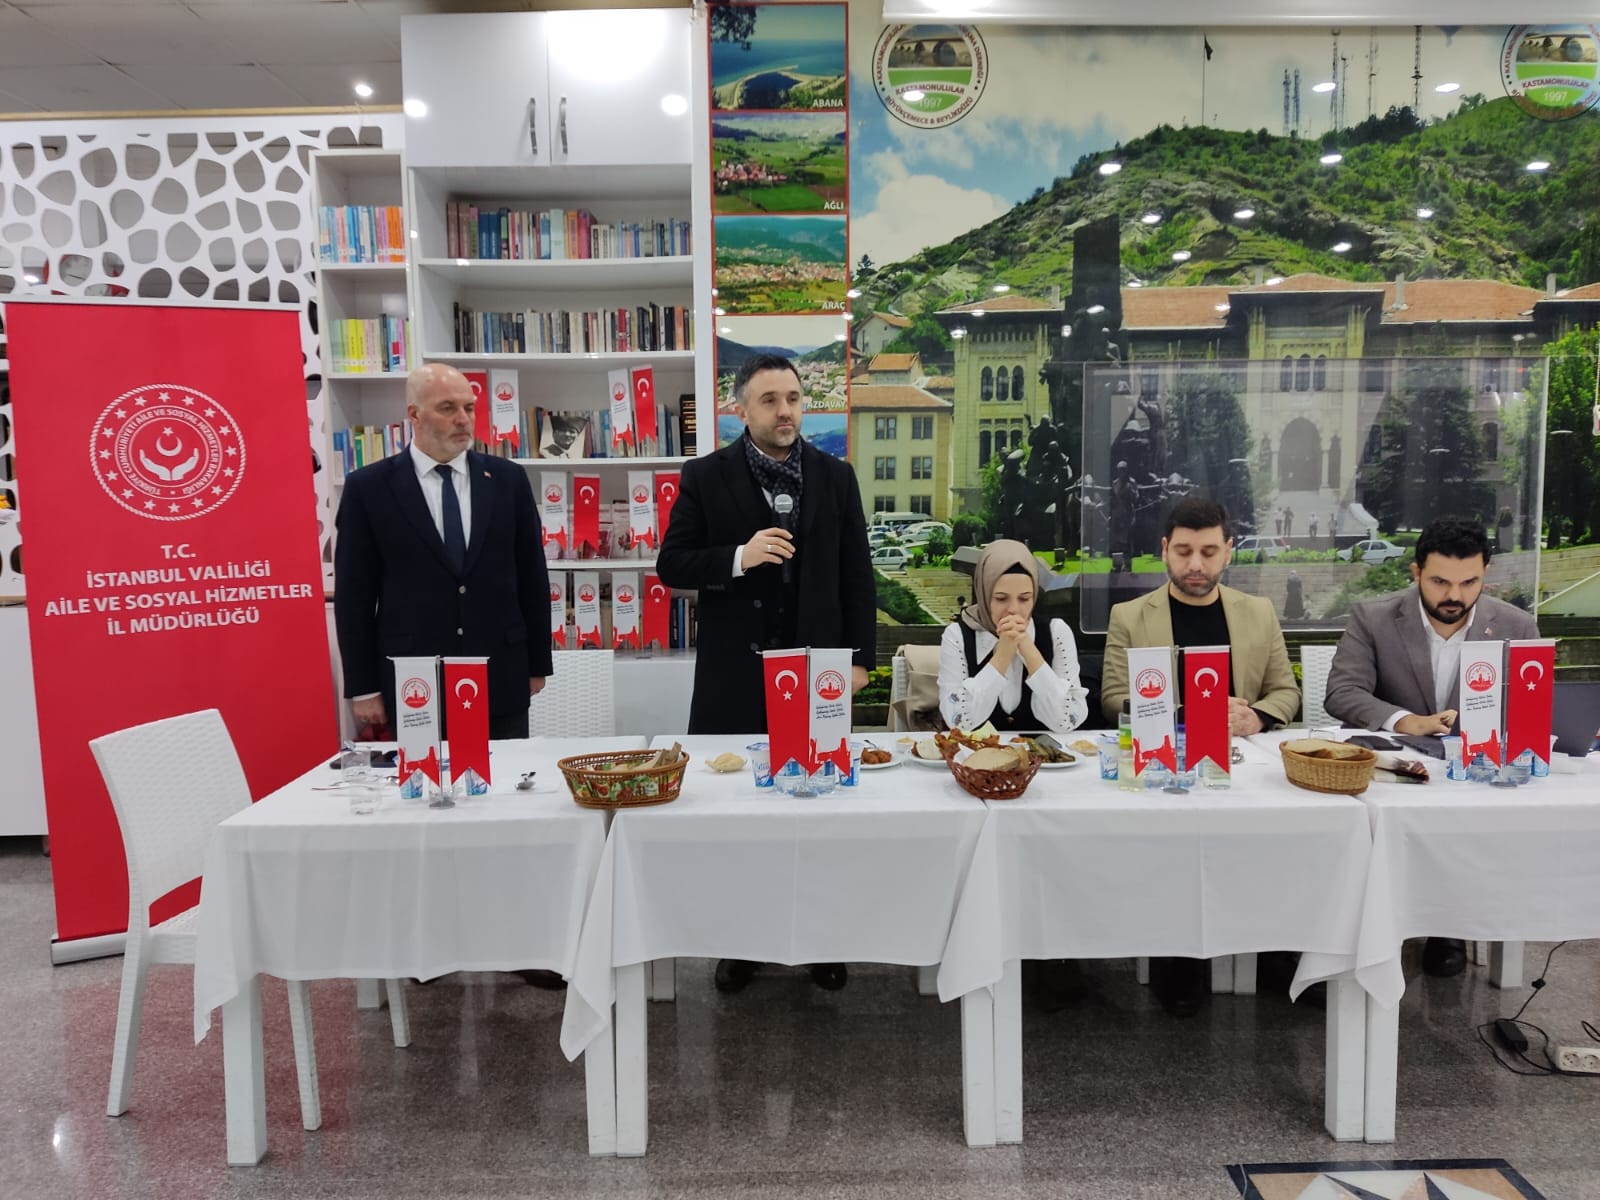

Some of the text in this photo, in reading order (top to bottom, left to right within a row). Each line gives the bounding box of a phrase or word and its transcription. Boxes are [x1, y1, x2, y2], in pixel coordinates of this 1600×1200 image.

[813, 99, 843, 107] ABANA
[824, 200, 844, 210] AĞLI
[821, 301, 846, 311] ARAÇ
[807, 400, 846, 409] AZDAVAY
[153, 408, 165, 416] VE
[166, 408, 197, 424] SOSYAL
[160, 543, 196, 559] T.C.
[87, 559, 271, 588] İSTANBUL VALİLİĞİ
[44, 583, 312, 616] AİLE VE SOSYAL HİZMETLER
[107, 606, 260, 635] İL MÜDÜRLÜĞÜ
